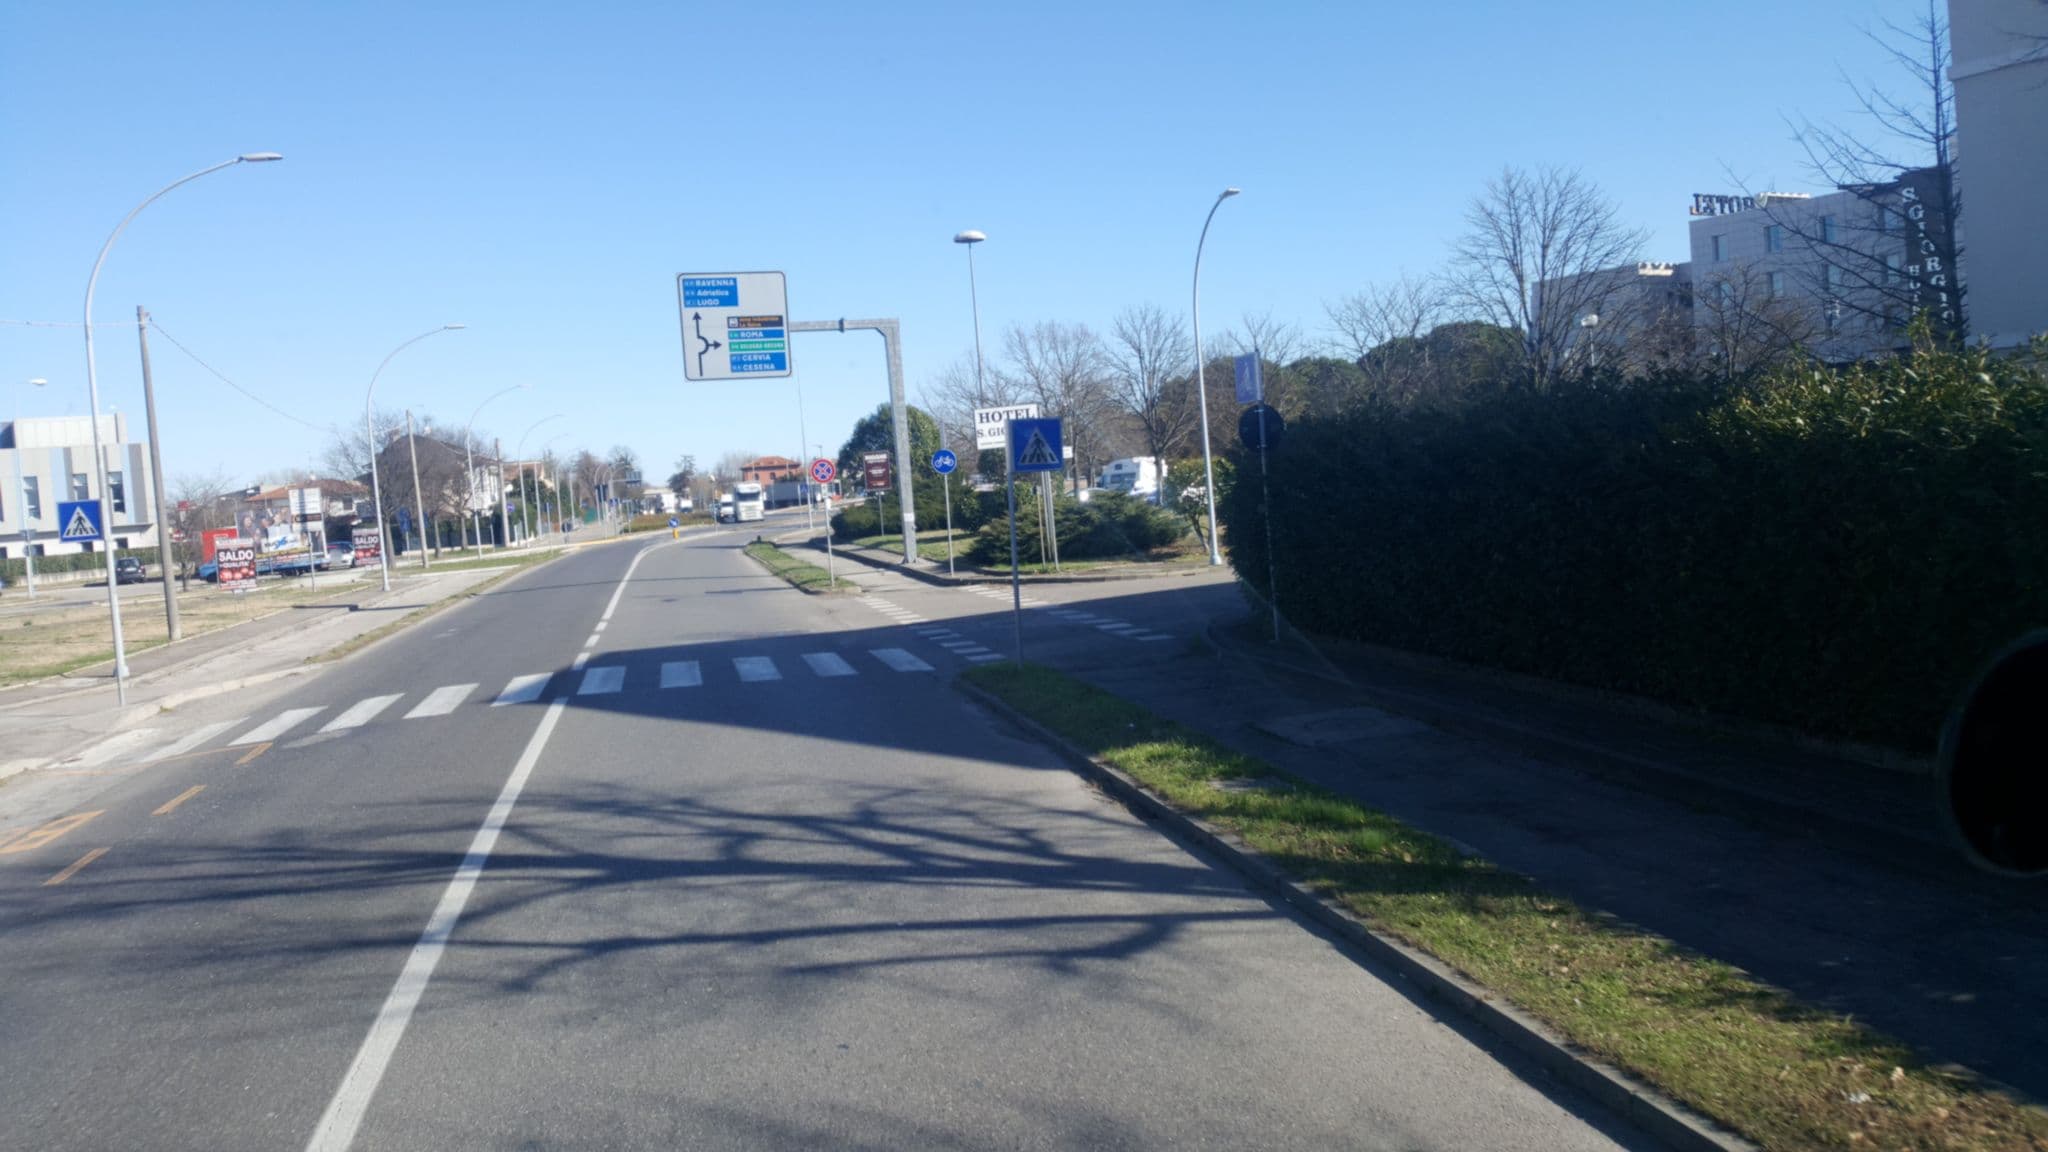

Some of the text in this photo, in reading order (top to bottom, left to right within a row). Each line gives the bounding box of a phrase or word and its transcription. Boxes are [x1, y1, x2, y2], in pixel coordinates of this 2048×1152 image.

[695, 279, 735, 287] RAVENNA
[697, 298, 720, 306] LUGO
[979, 407, 1036, 424] HOTEL
[219, 550, 254, 562] SALDO
